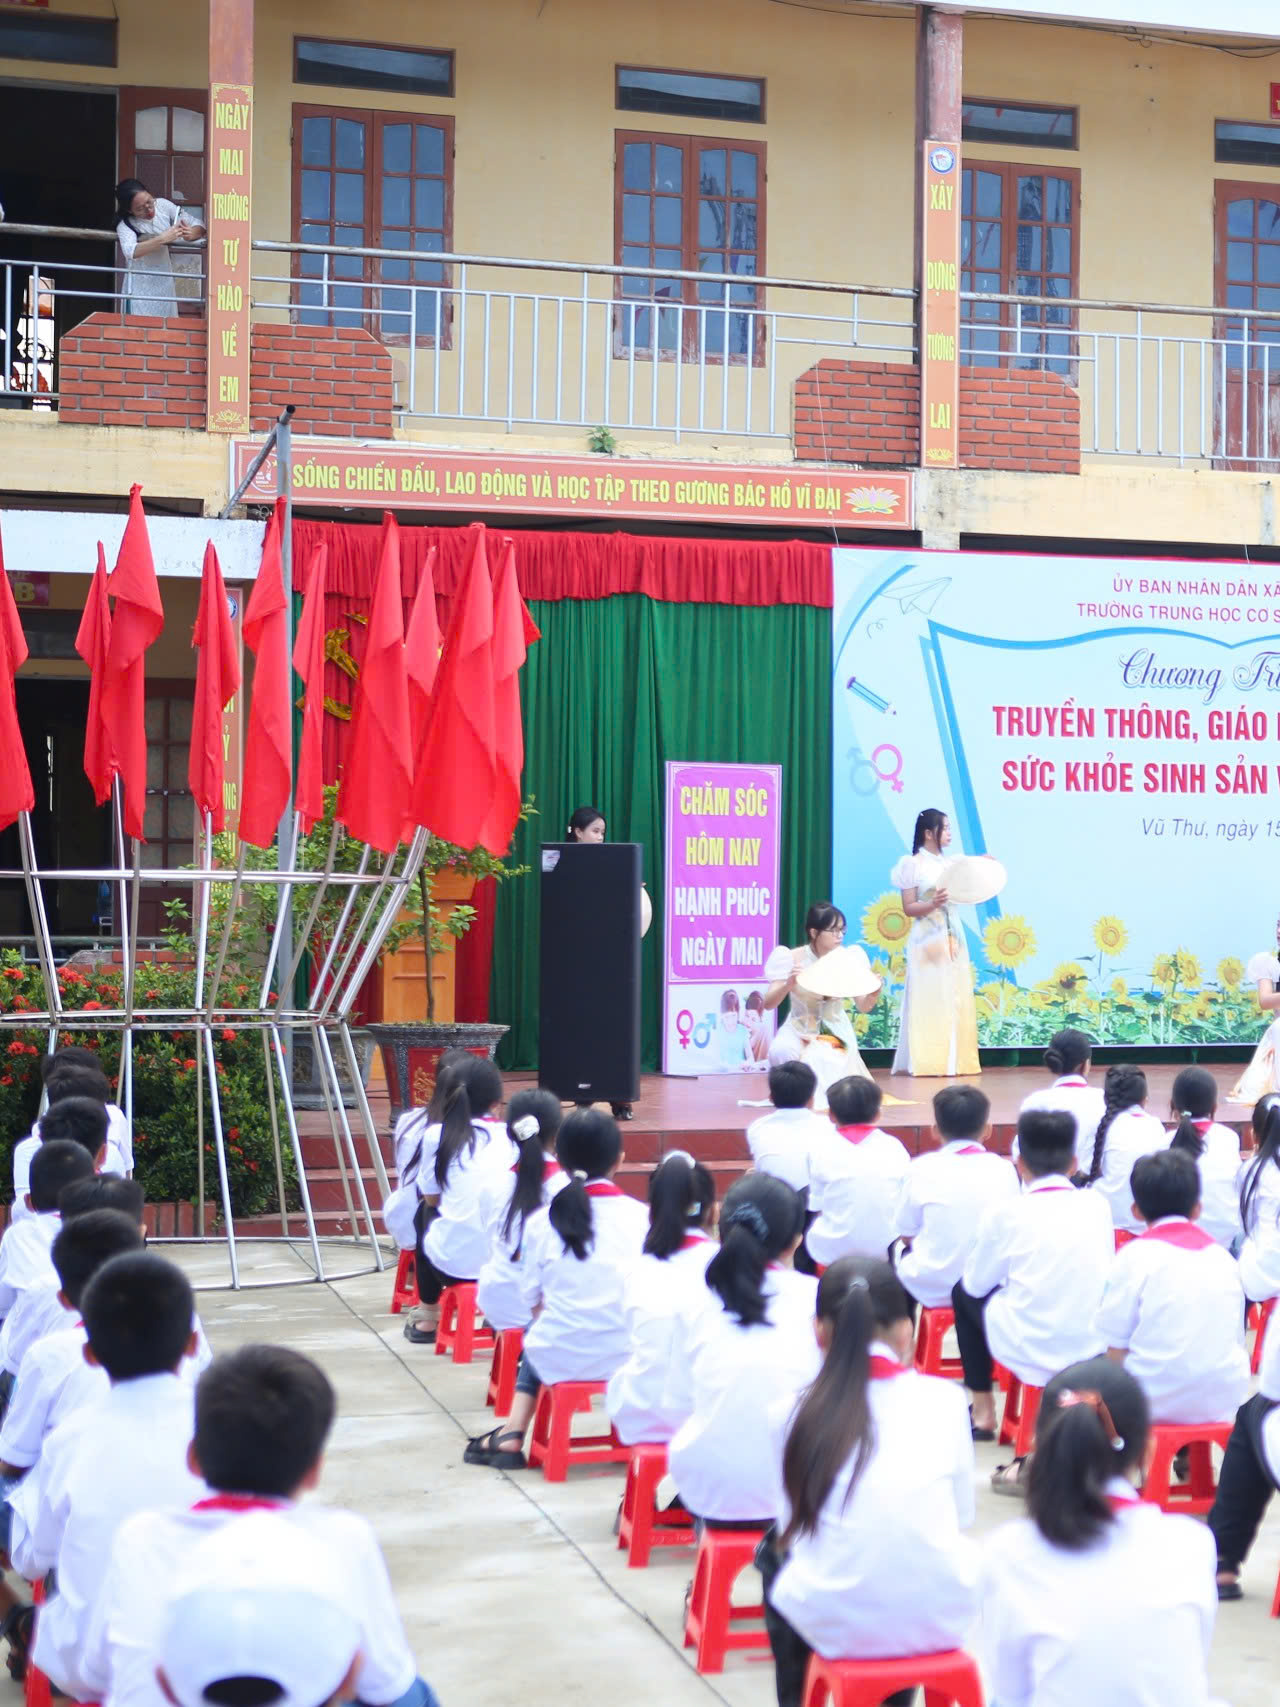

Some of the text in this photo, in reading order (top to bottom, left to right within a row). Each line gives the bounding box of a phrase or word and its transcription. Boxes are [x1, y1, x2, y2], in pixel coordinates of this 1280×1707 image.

[215, 98, 249, 130] NGÀY
[219, 148, 244, 176] MAI
[213, 188, 249, 222] TRƯỜNG
[930, 179, 953, 211] XÂY
[223, 238, 240, 272] TỰ
[927, 259, 956, 297] DỰNG
[217, 280, 243, 312] HÀO
[222, 322, 238, 357] VỀ
[219, 375, 239, 403] EM
[930, 402, 951, 430] LAI
[293, 456, 340, 489] SỐNG
[345, 460, 396, 492] CHIẾN
[401, 461, 441, 496] ĐẤU,
[445, 471, 476, 495] LAO
[481, 468, 527, 501] ĐỘNG
[531, 470, 552, 498] VÀ
[557, 475, 590, 504] HỌC
[595, 473, 626, 506] TẬP
[630, 479, 670, 503] THEO
[675, 480, 729, 506] GƯƠNG
[734, 479, 766, 507] BÁC
[770, 478, 792, 509] HỒ
[796, 482, 811, 510] VĨ
[815, 487, 841, 515] ĐẠI
[1113, 572, 1134, 593] ỦY
[1139, 579, 1172, 594] BAN
[1177, 577, 1221, 596] NHÂN
[1226, 579, 1258, 597] DÂN
[1076, 600, 1143, 619] TRƯỜNG
[1149, 605, 1203, 621] TRUNG
[1209, 606, 1241, 625] HỌC
[1246, 607, 1269, 623] CƠ
[1119, 647, 1223, 702] Chương
[992, 697, 1095, 738] TRUYỀN
[1104, 702, 1199, 744] THÔNG,
[1208, 704, 1268, 741] GIÁO
[1002, 754, 1055, 792] SỨC
[1065, 751, 1133, 793] KHỎE
[1143, 762, 1206, 794] SINH
[1215, 754, 1268, 794] SẢN
[680, 781, 768, 817] CHĂM SÓC
[1142, 818, 1165, 836] Vũ
[1172, 818, 1209, 838] Thư,
[1216, 819, 1258, 841] ngày
[685, 830, 761, 866] HÔM NAY
[675, 881, 771, 923] HẠNH PHÚC
[681, 930, 763, 966] NGÀY MAI
